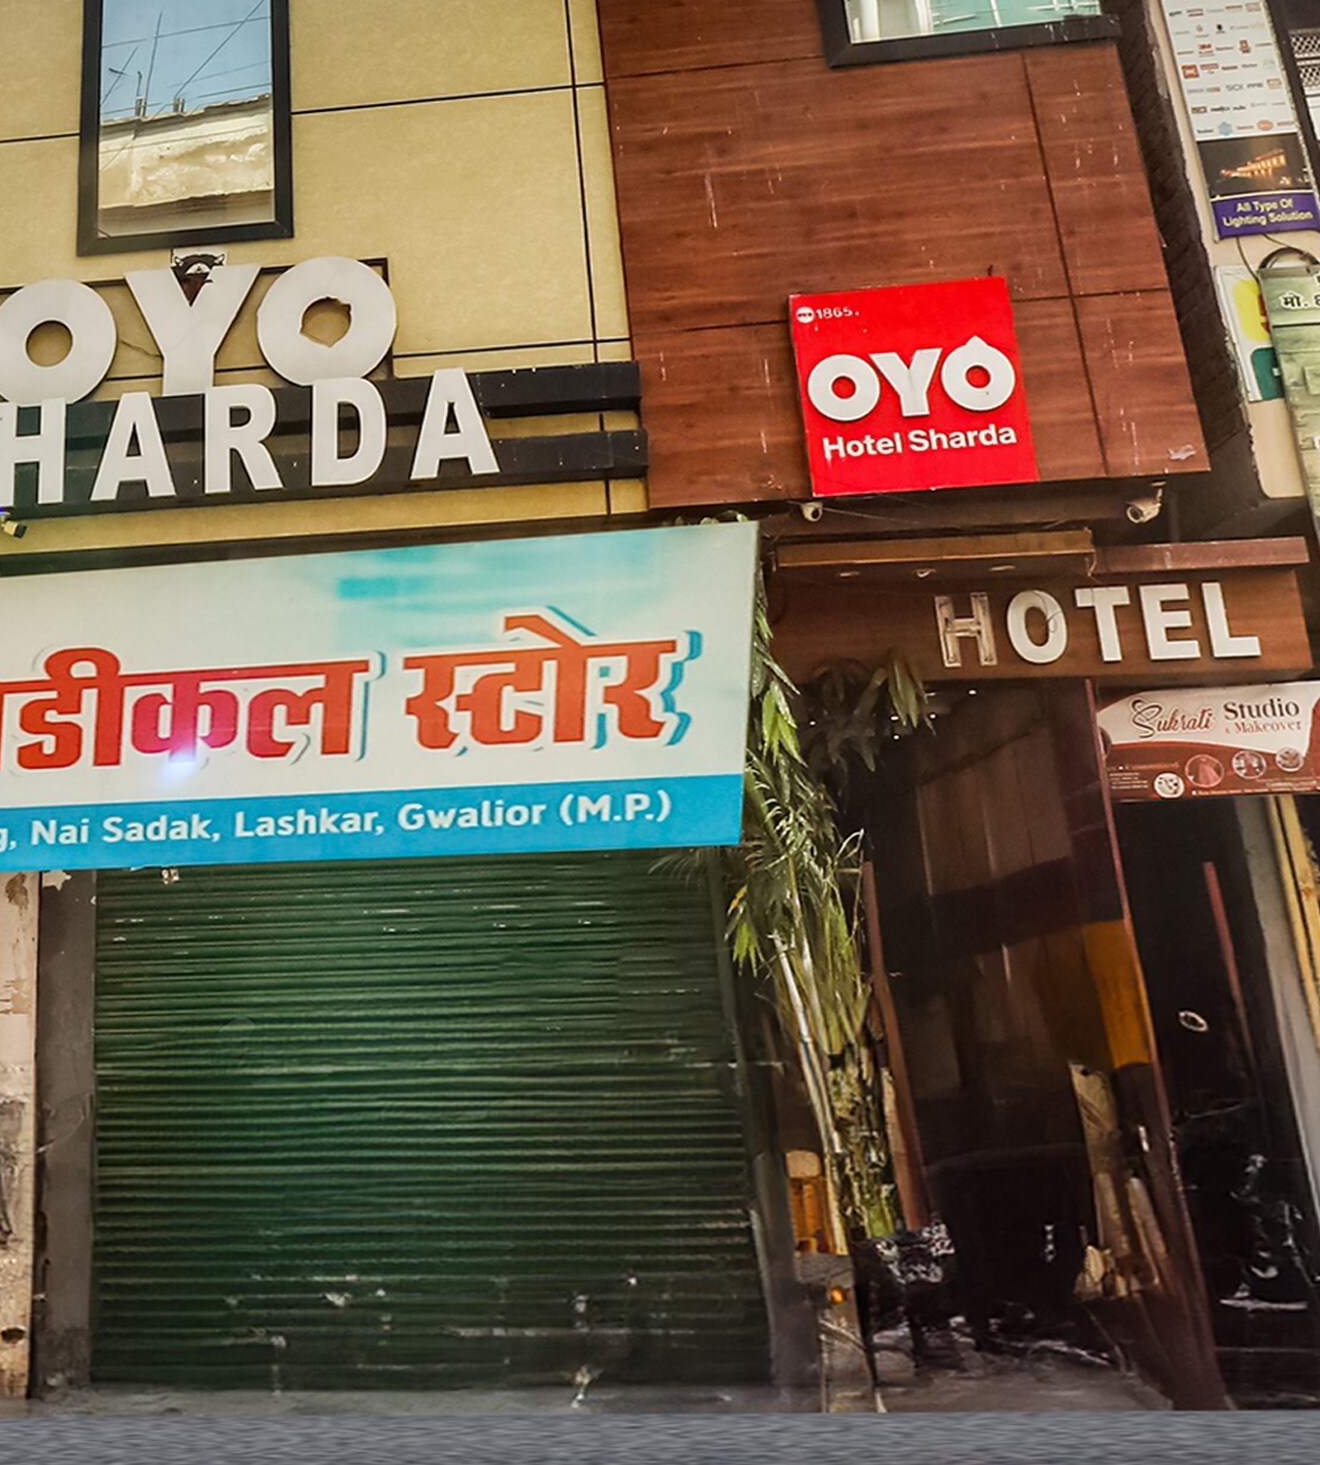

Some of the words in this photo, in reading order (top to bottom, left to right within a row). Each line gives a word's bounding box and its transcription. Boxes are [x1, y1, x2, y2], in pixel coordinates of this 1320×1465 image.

[1222, 215, 1267, 228] Lighting
[1268, 211, 1313, 222] Solution
[1236, 201, 1251, 212] All
[1252, 200, 1278, 213] Type
[1279, 198, 1293, 208] Of
[1282, 292, 1307, 309] मो.
[807, 335, 1016, 422] OYO
[823, 432, 902, 460] Hotel
[909, 424, 1017, 453] Sharda
[934, 582, 1261, 667] HOTEL
[403, 613, 677, 749] स्टोर
[1223, 698, 1299, 720] Studio
[1235, 720, 1302, 735] Makeover
[32, 816, 89, 845] Nai
[102, 815, 220, 843] Sadak,
[235, 806, 384, 839] Lashkar,
[398, 801, 546, 831] Gwalior
[559, 789, 671, 826] (M.P.)
